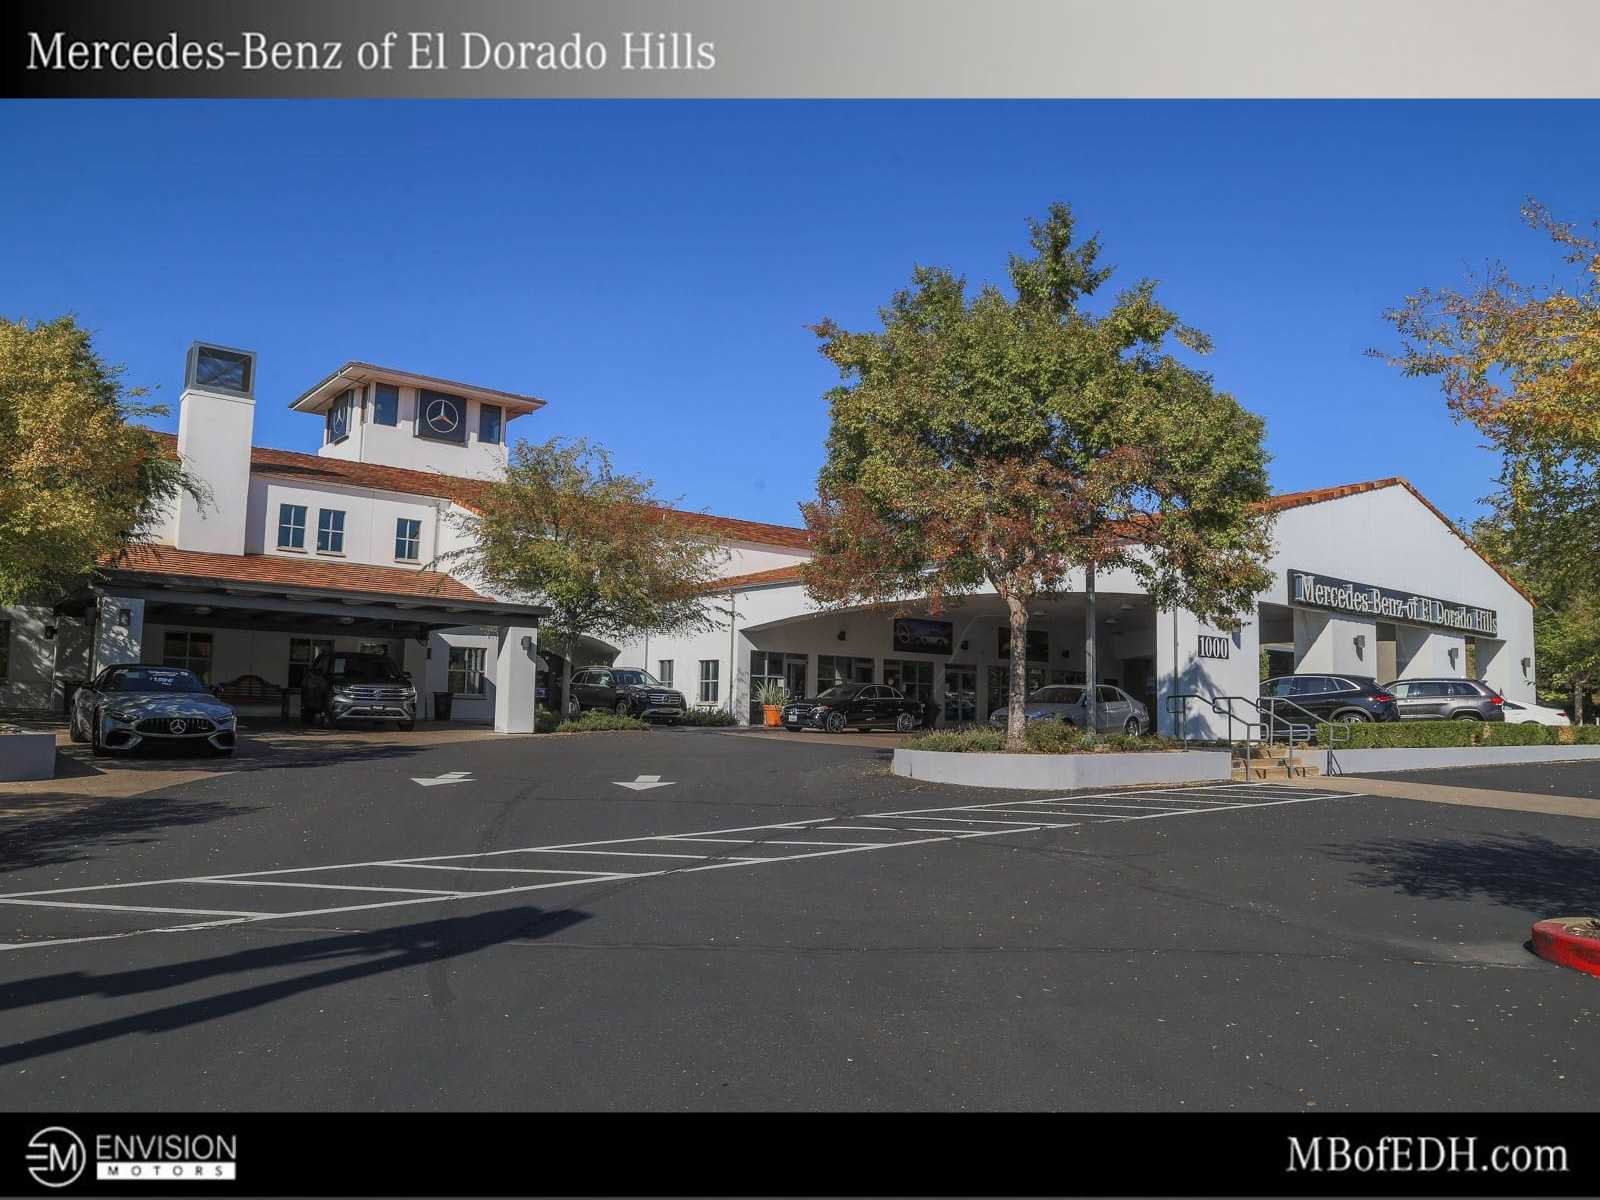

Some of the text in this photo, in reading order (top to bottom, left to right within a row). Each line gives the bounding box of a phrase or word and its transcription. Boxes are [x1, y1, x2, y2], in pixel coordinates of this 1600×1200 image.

[1294, 573, 1497, 633] Mercedes-Benz of El Dorado Hills
[1199, 635, 1228, 658] 1000
